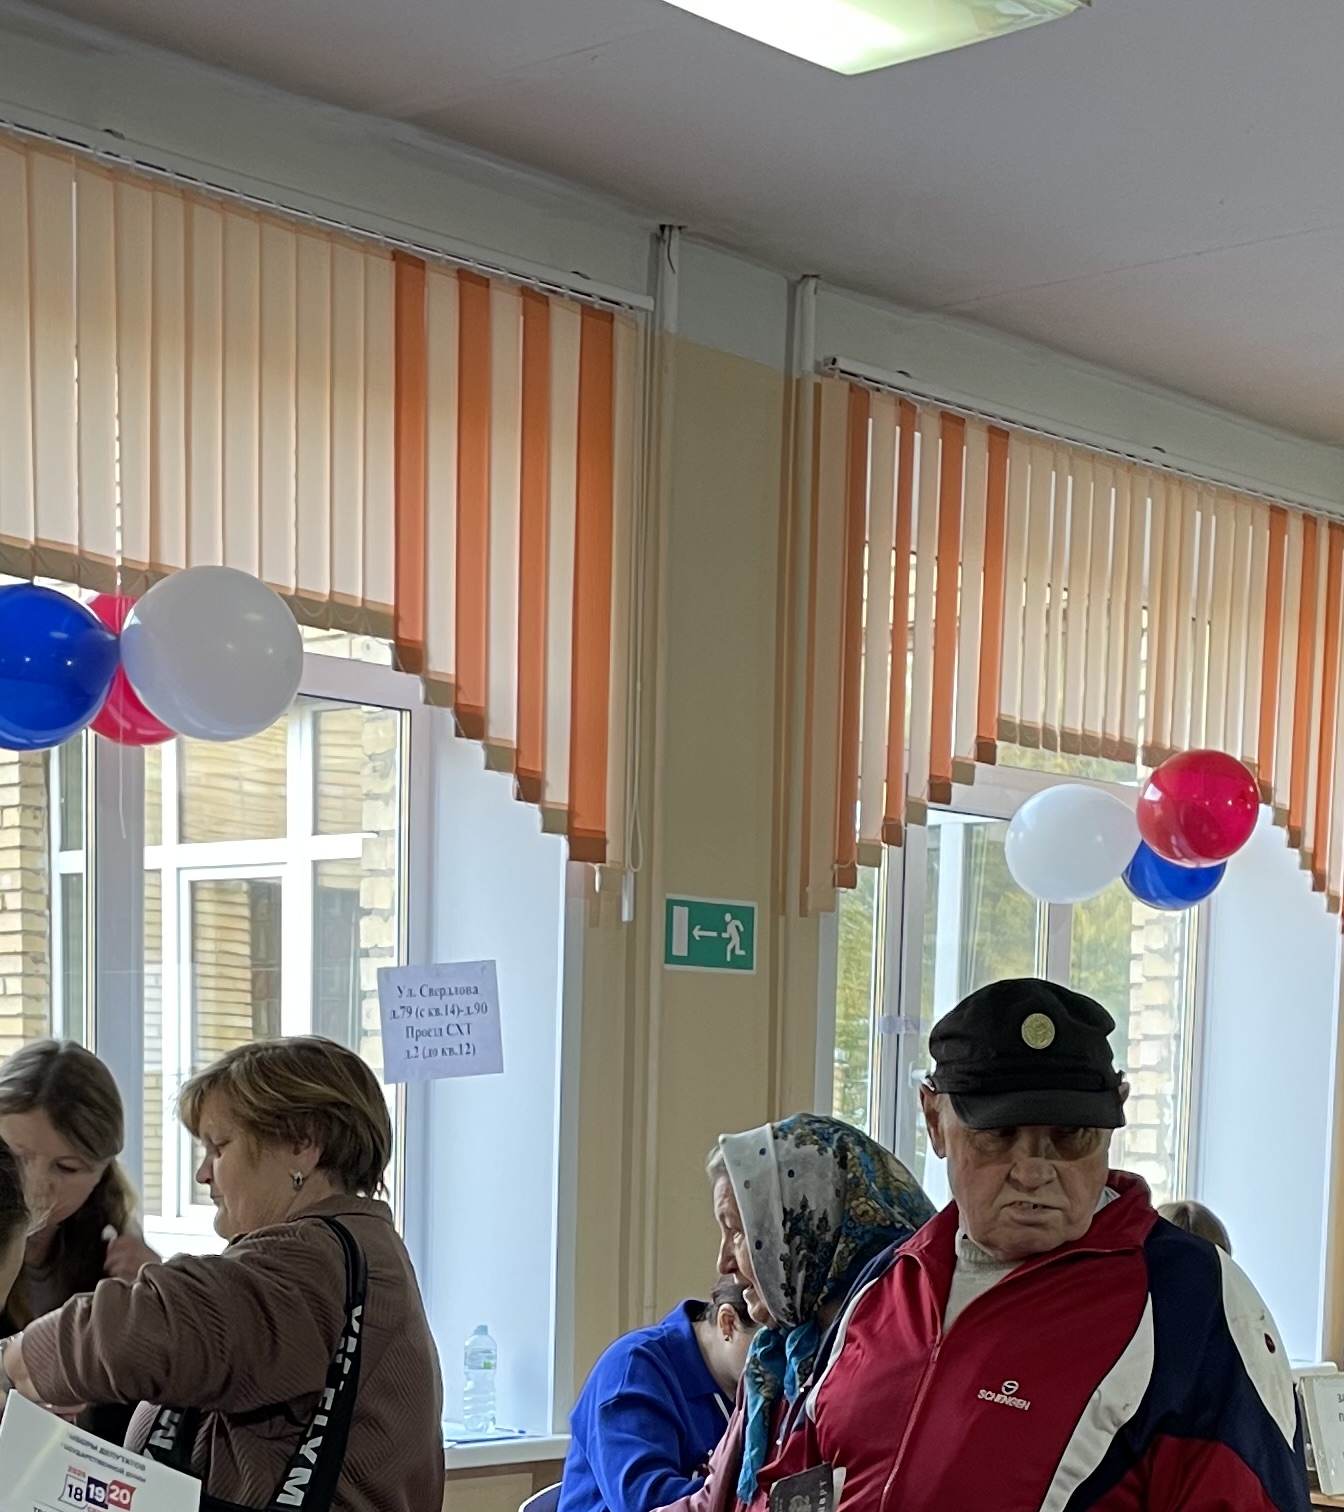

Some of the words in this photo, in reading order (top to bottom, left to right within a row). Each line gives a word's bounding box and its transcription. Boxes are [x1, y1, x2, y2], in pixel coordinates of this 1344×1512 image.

[397, 985, 416, 998] Ул.
[419, 984, 479, 1000] Свердлова
[390, 1006, 412, 1020] д.79
[446, 1022, 473, 1036] СХТ
[441, 1042, 476, 1057] кв.12)
[67, 1483, 84, 1502] 18
[87, 1483, 107, 1503] 19
[109, 1484, 131, 1505] 20
